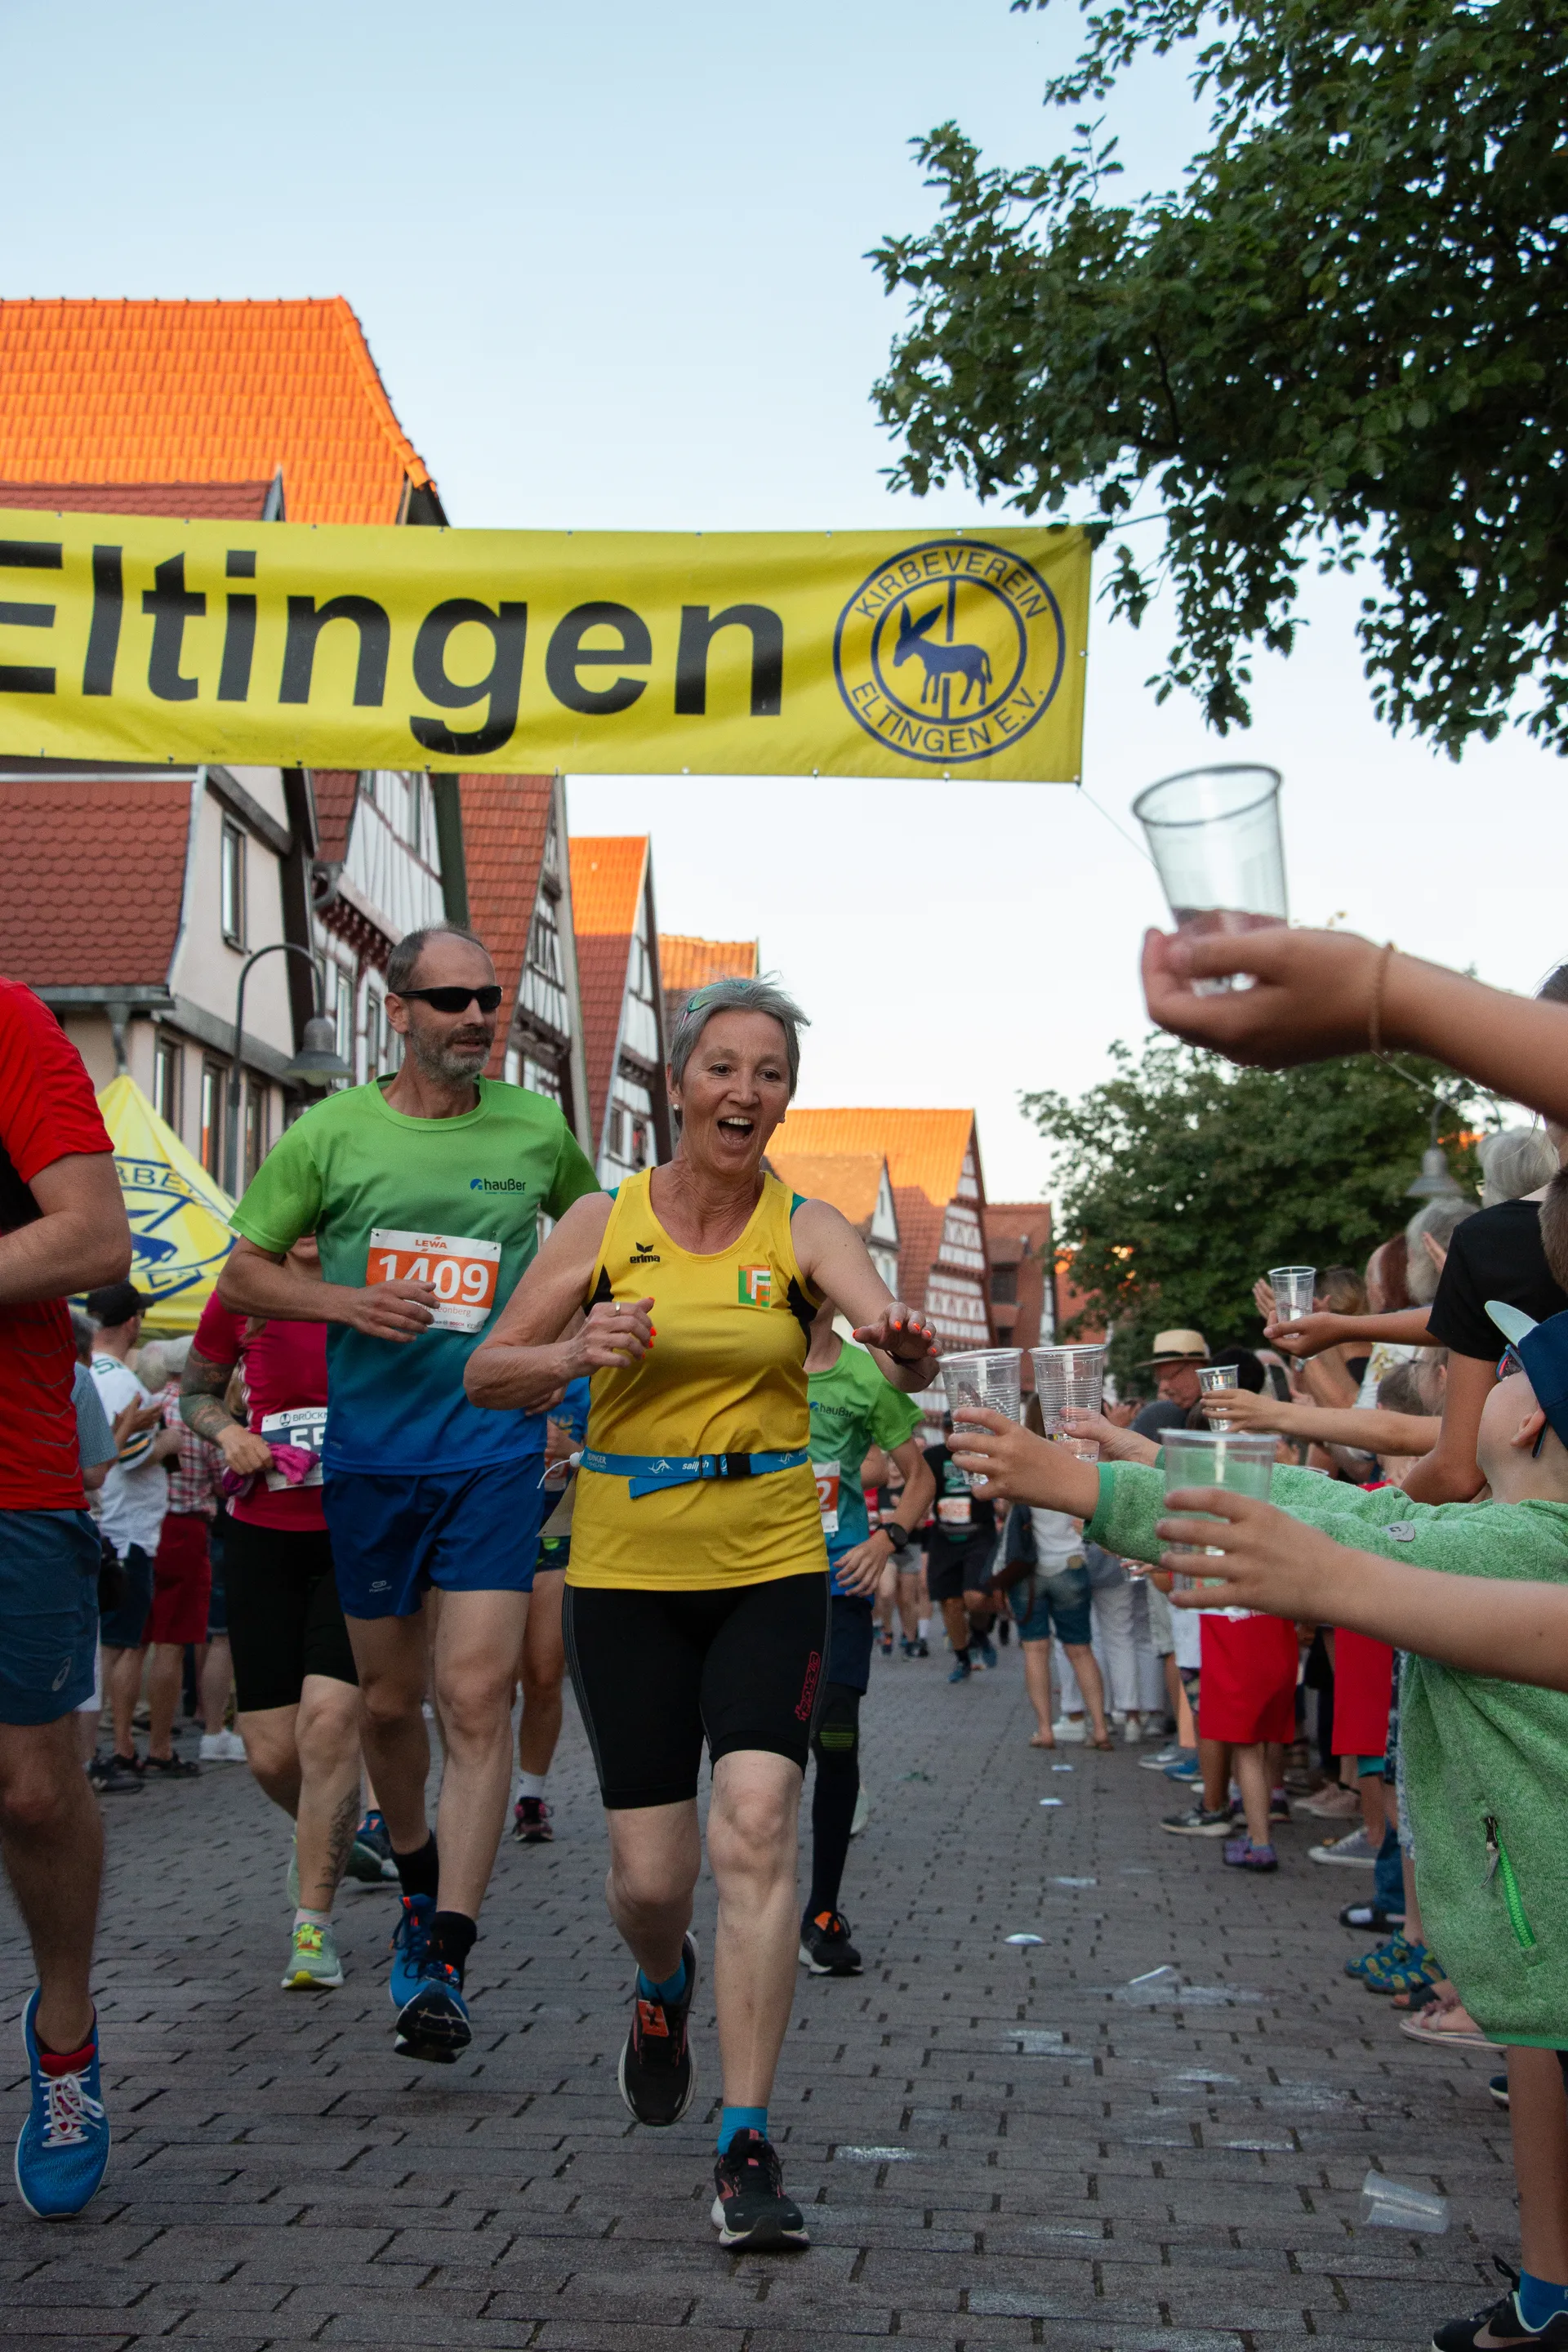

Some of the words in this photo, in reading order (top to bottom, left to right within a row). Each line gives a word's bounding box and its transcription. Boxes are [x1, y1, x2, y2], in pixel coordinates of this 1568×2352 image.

[856, 549, 1047, 620] KIRBEVEREIN
[851, 680, 991, 755] ELTINGEN
[996, 687, 1045, 734] E.V.
[483, 1178, 527, 1191] haußer
[414, 1239, 448, 1249] LEWA
[630, 1254, 661, 1264] erima
[379, 1254, 489, 1303] 1409
